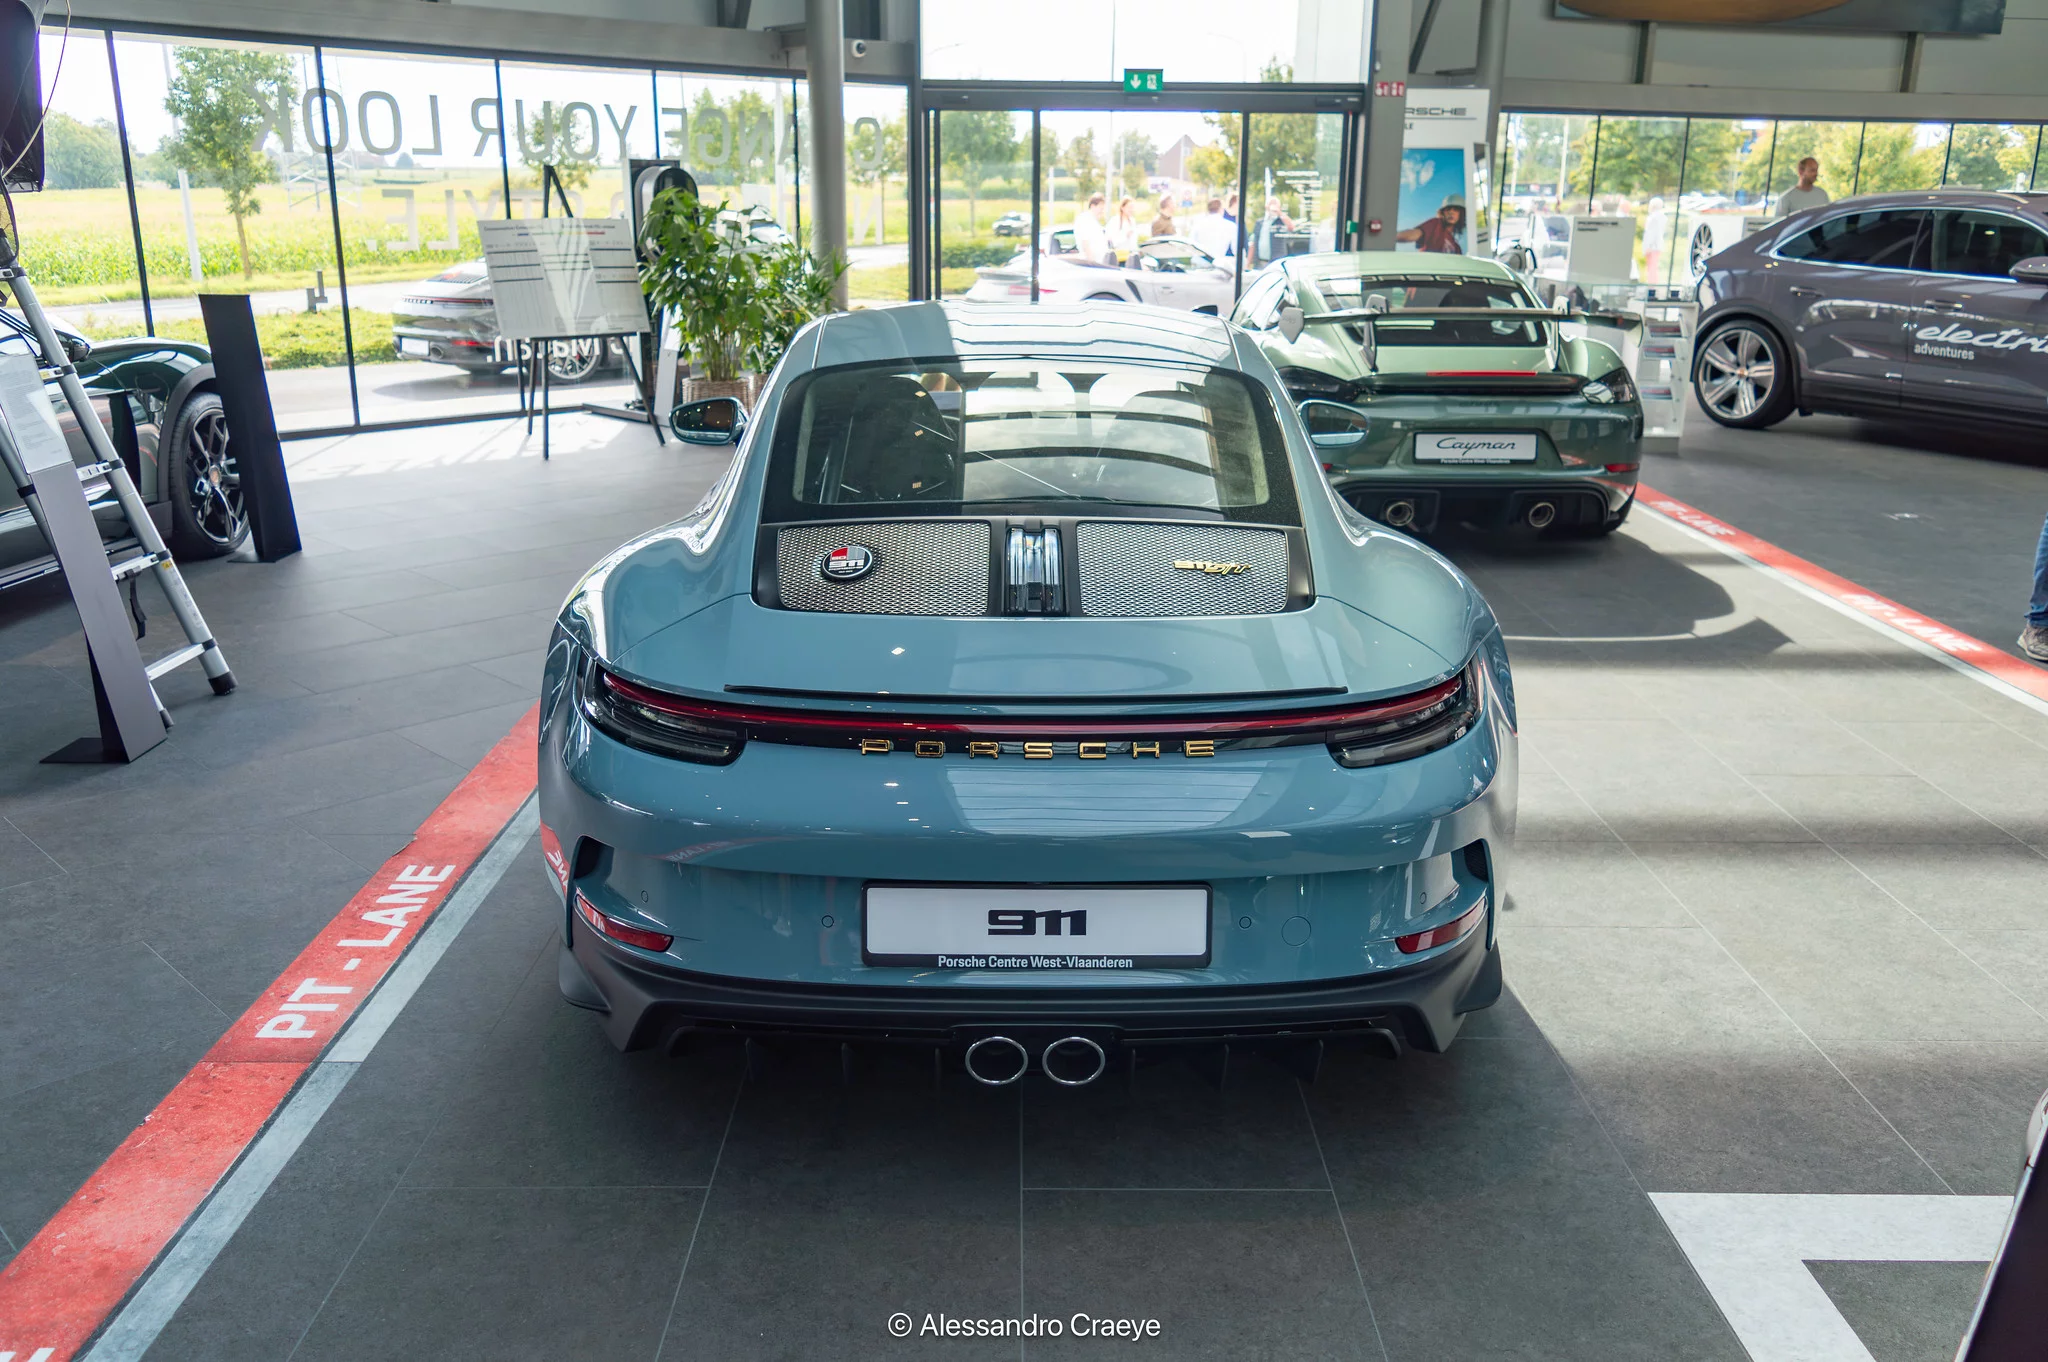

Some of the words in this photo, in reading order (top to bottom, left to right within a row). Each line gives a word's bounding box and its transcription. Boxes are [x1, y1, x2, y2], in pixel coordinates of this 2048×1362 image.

[1916, 323, 2048, 353] electri
[1914, 343, 1975, 360] adventures
[1436, 437, 1516, 456] Cayman
[861, 738, 1215, 759] PORSCHE
[987, 909, 1087, 936] 911
[255, 977, 353, 1039] PIT
[336, 864, 457, 947] LANE
[938, 955, 986, 968] Porsche
[988, 955, 1028, 968] Centre
[1030, 955, 1133, 968] West-Vlaanderen
